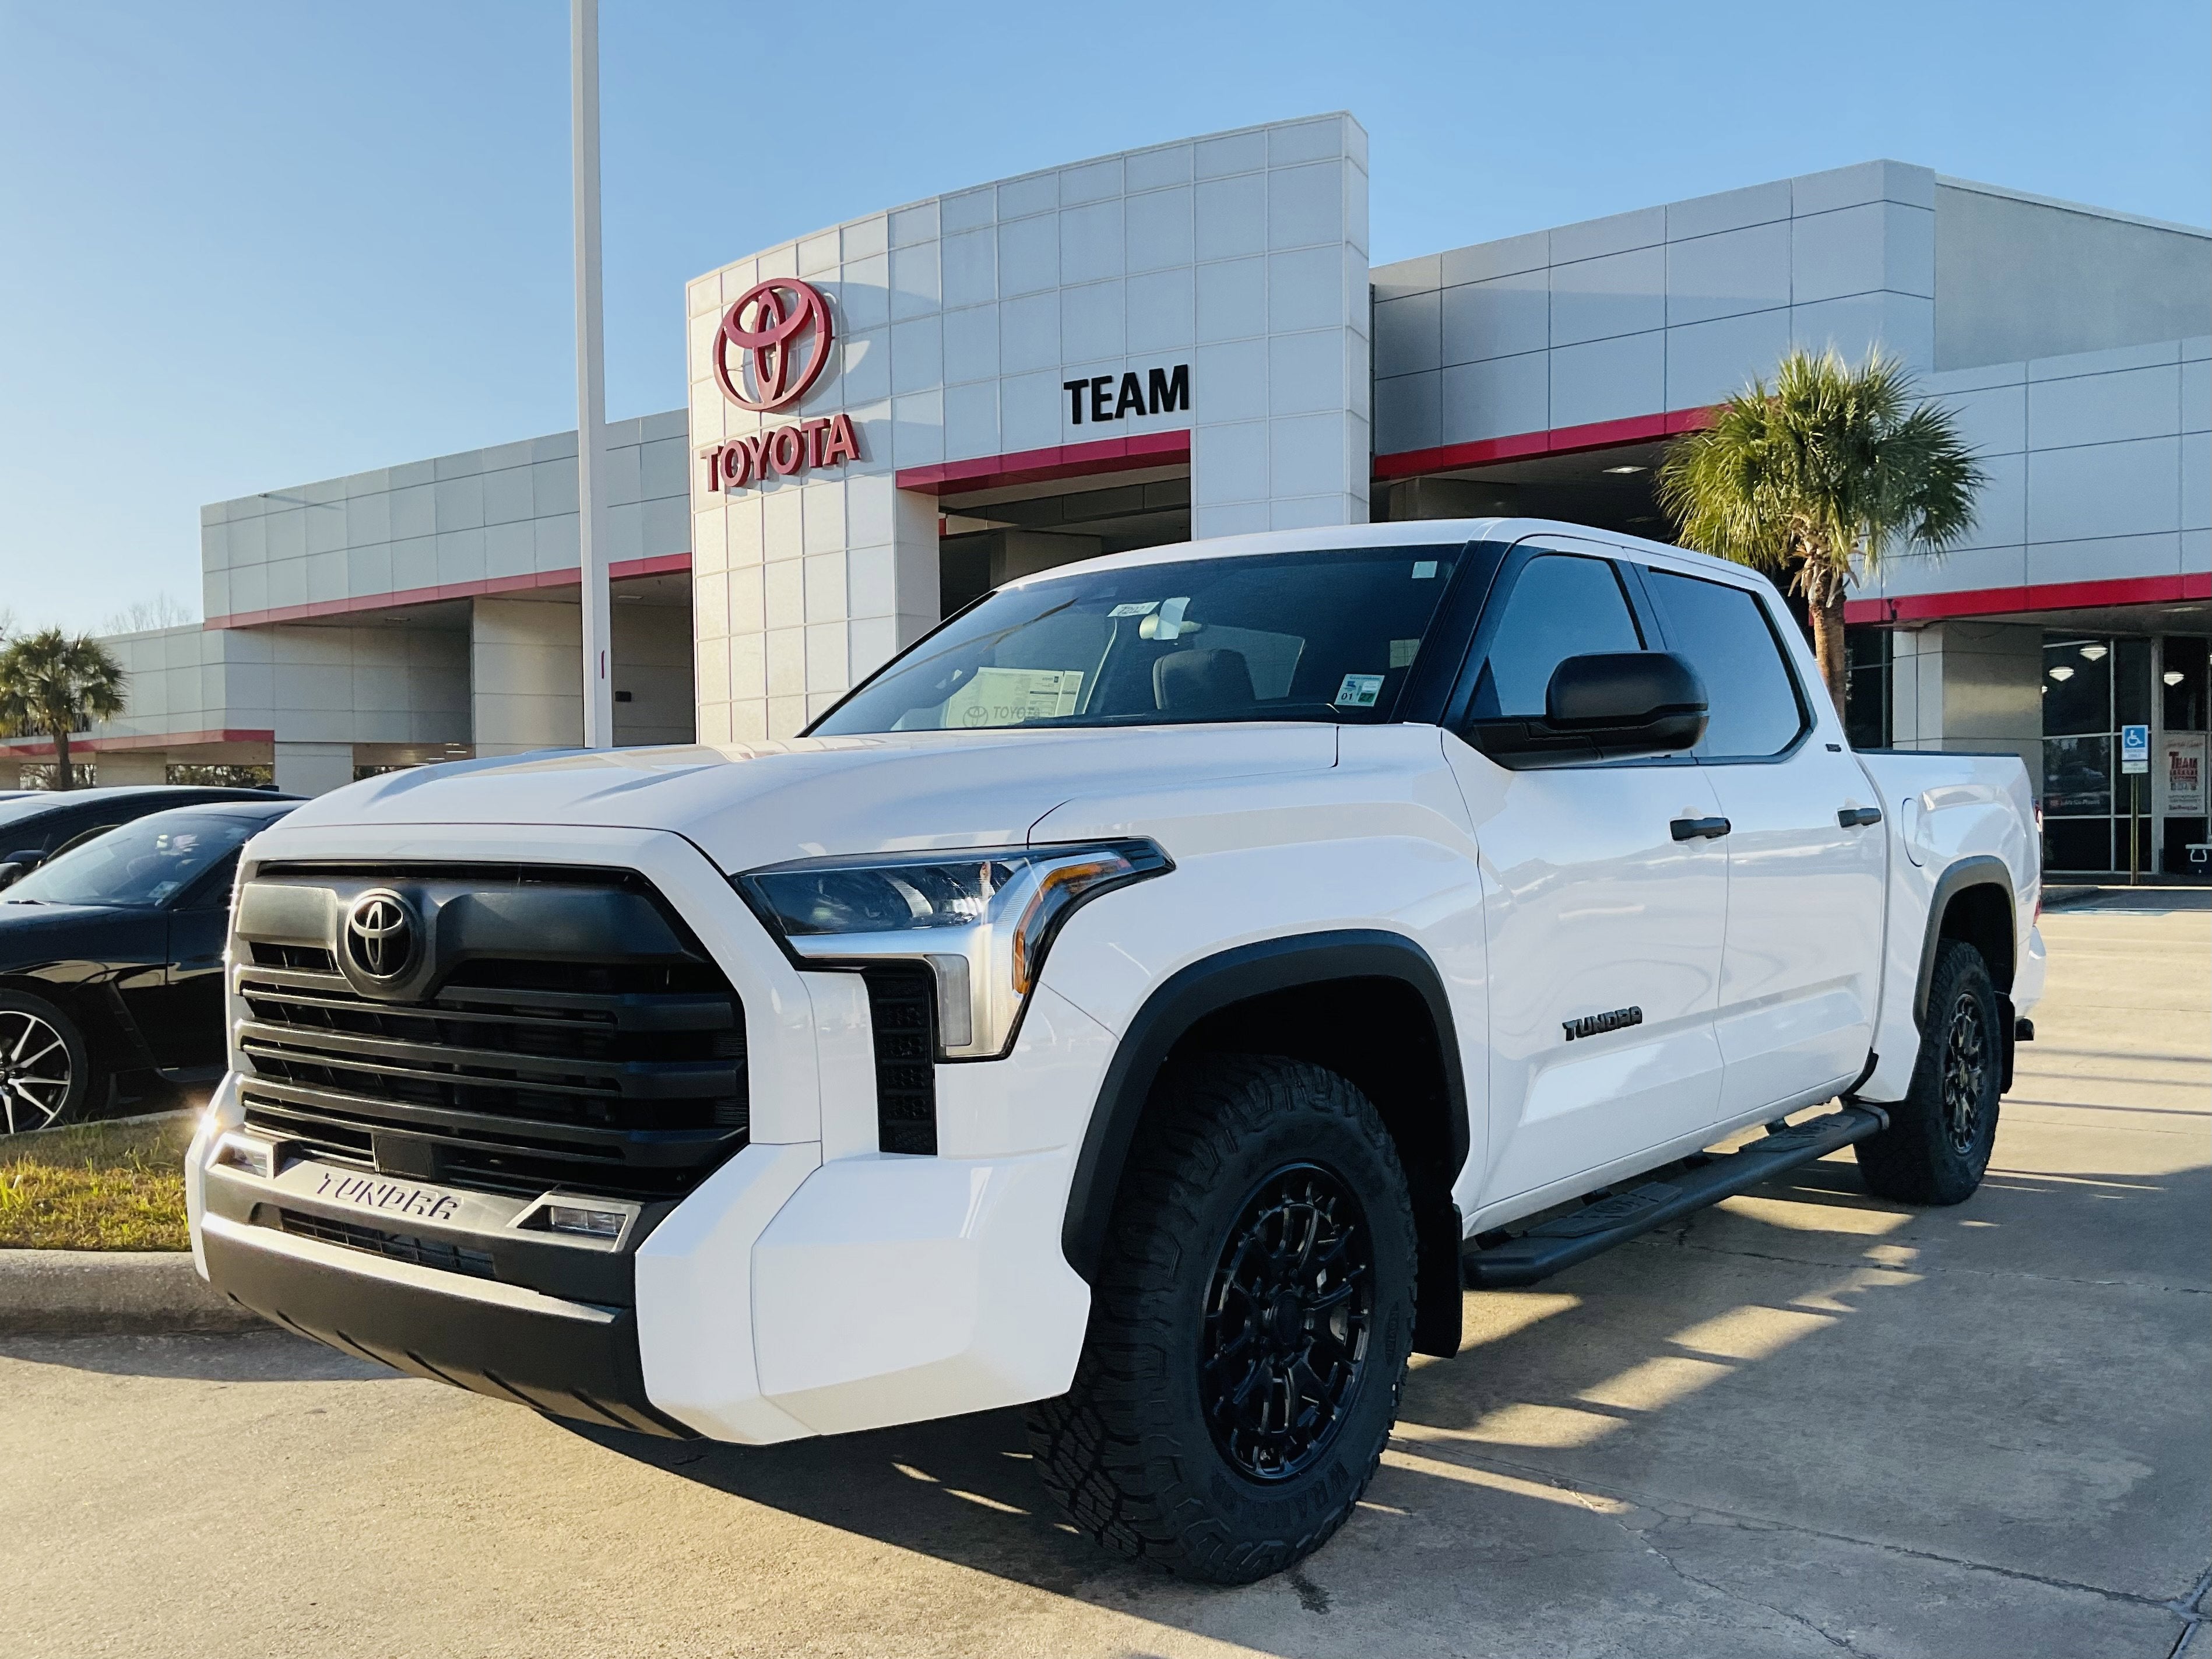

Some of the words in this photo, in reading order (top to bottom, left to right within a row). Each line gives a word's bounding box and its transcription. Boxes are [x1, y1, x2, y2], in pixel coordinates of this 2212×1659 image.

[1064, 364, 1190, 424] TEAM
[700, 414, 860, 493] TOYOTA
[1562, 1006, 1643, 1041] TUNDRA
[316, 1172, 465, 1220] TUNDRA
